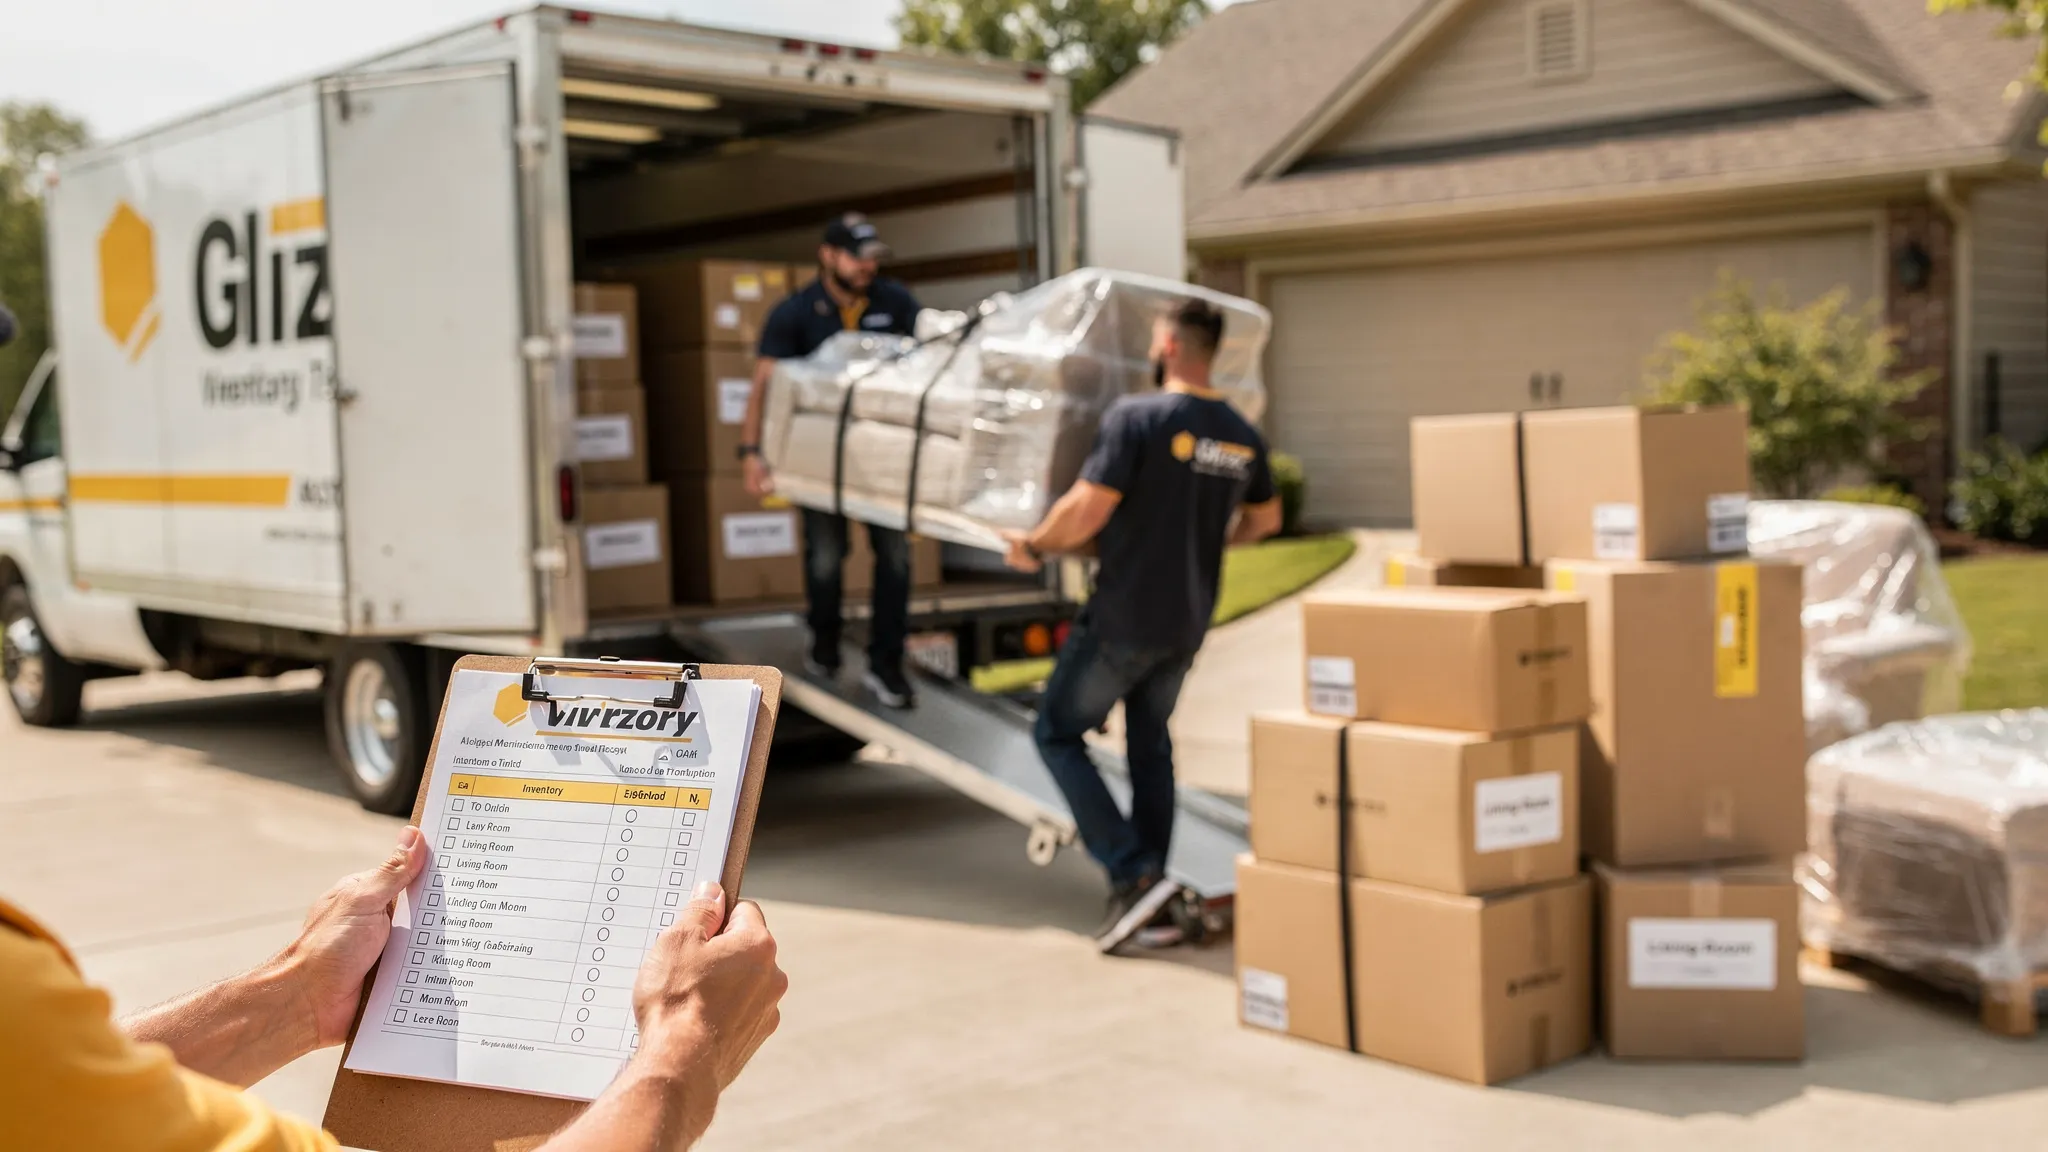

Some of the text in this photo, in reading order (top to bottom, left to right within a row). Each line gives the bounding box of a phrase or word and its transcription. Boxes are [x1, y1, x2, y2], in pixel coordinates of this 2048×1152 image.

[522, 784, 564, 797] Inventory
[462, 839, 514, 852] Living Room
[483, 860, 508, 871] Room
[468, 918, 493, 929] Room
[465, 957, 491, 969] Room
